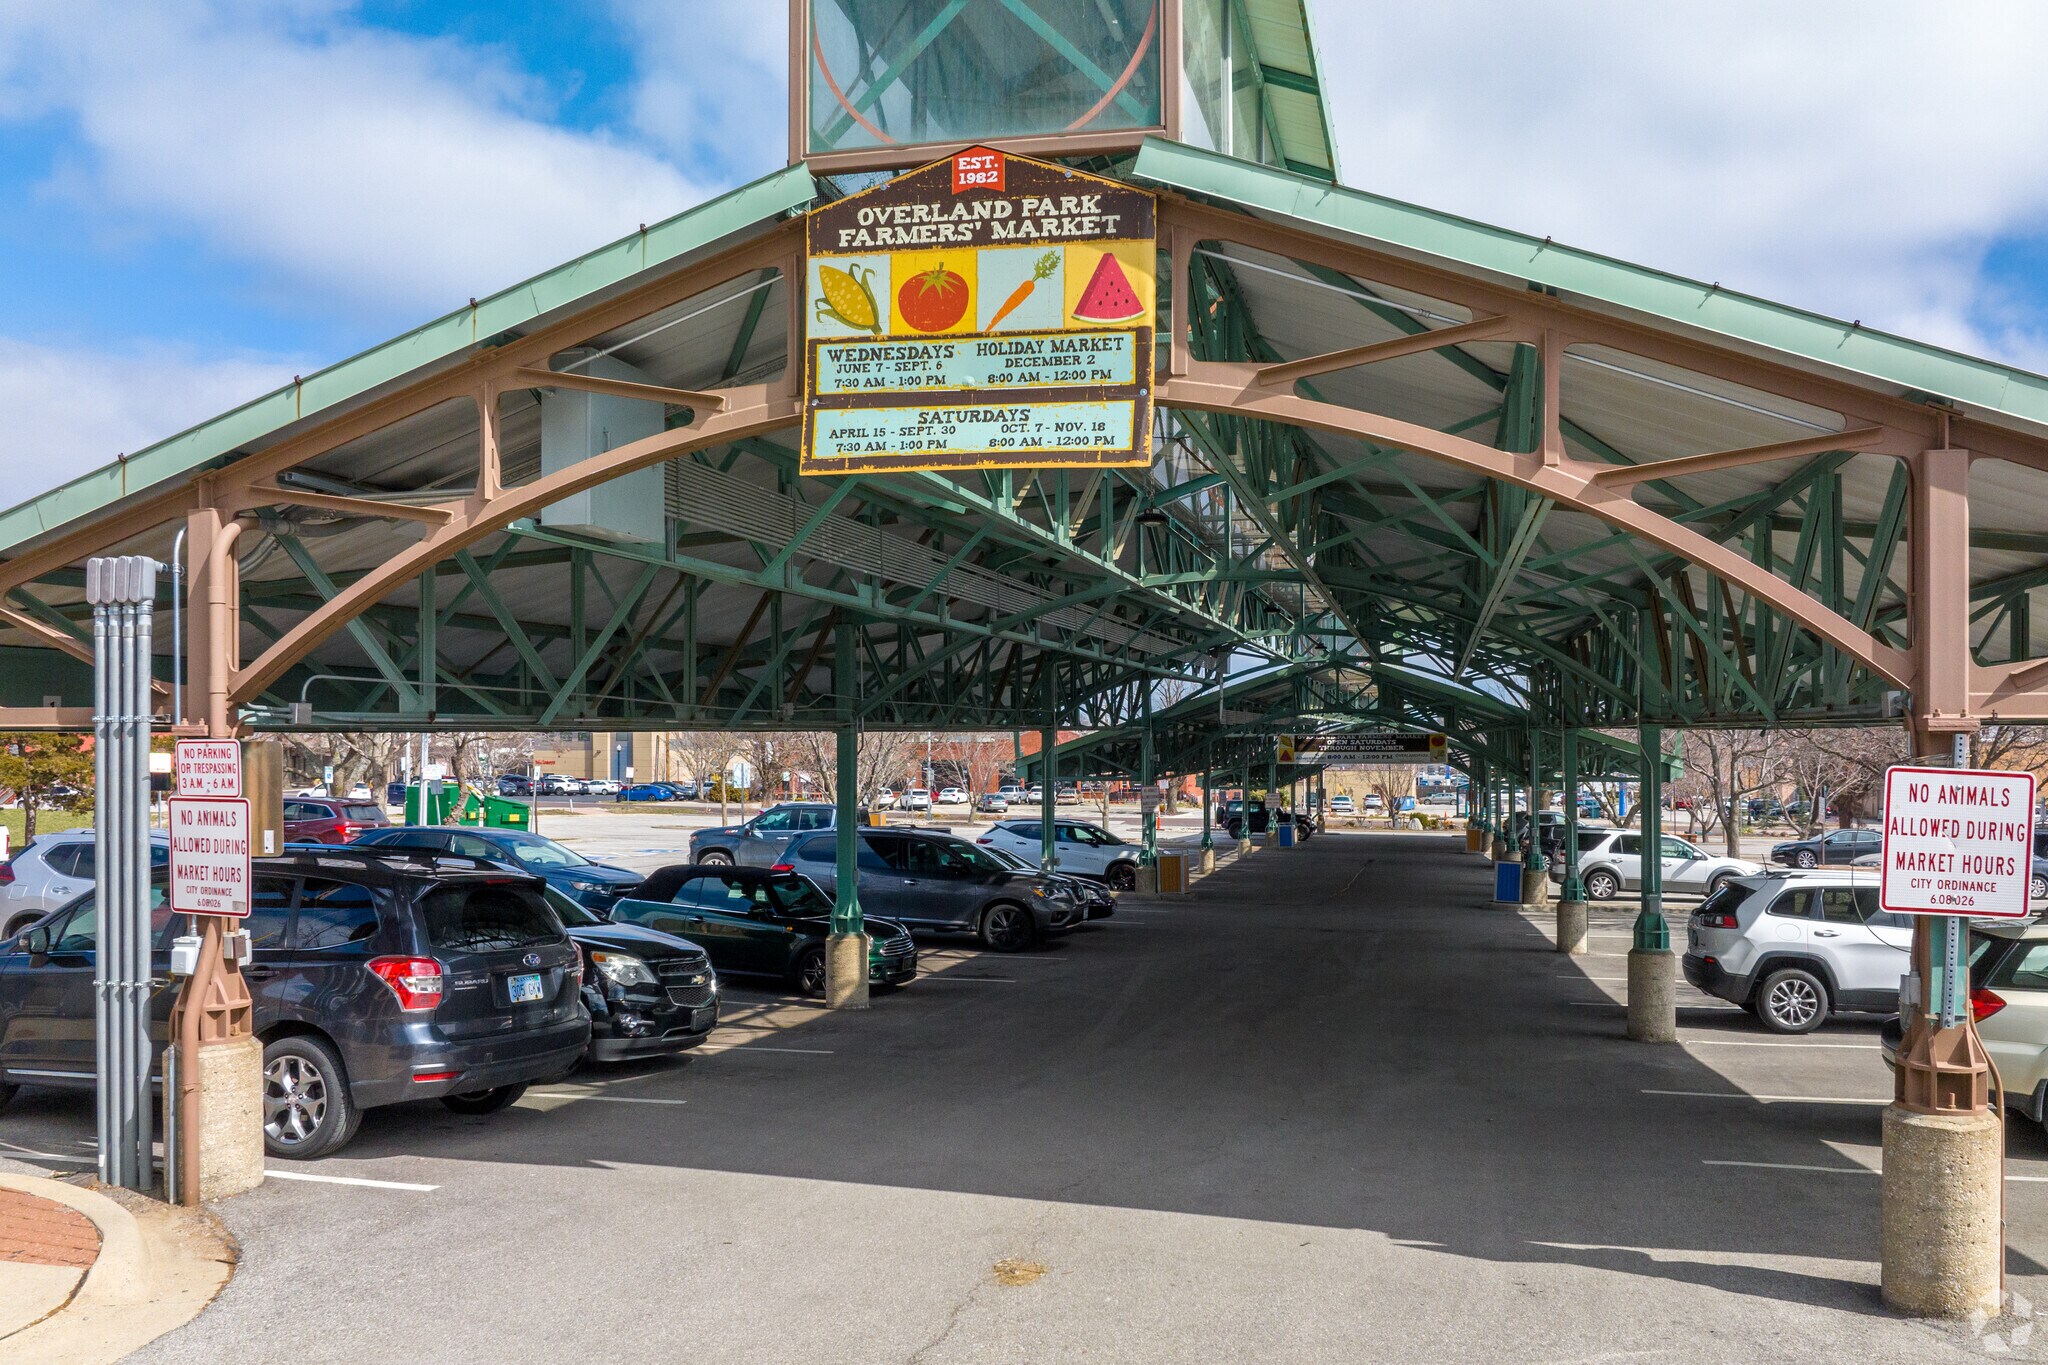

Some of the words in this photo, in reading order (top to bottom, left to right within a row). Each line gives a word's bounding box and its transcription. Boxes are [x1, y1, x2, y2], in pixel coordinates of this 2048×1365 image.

[958, 155, 998, 170] EST.
[958, 170, 998, 185] 1982
[857, 200, 1013, 226] OVERLAND
[1021, 194, 1102, 217] PARK
[839, 222, 982, 247] FARMERS'
[991, 214, 1121, 240] MARKET
[827, 345, 955, 362] WEDNESDAYS
[977, 340, 1044, 357] HOLIDAY
[1050, 337, 1124, 353] MARKET
[837, 363, 870, 374] JUNE
[875, 363, 884, 373] 7
[894, 361, 932, 372] SEPT.
[936, 361, 942, 370] 6
[1005, 355, 1082, 368] DECEMBER
[1087, 355, 1096, 365] 2
[834, 378, 860, 388] 7:30
[863, 377, 886, 387] AM
[899, 376, 922, 386] 1:00
[926, 375, 946, 386] PM
[988, 373, 1014, 384] 8:00
[1017, 372, 1040, 383] AM
[1054, 370, 1086, 381] 12:00
[1091, 369, 1112, 380] PM
[918, 409, 1031, 424] SATURDAYS
[829, 428, 869, 439] APRIL
[872, 428, 886, 438] 15
[899, 426, 936, 437] SEPT.
[941, 425, 956, 435] 30
[1001, 423, 1030, 434] OCT.
[1035, 422, 1044, 432] 7
[1054, 422, 1086, 432] NOV.
[1091, 422, 1106, 432] 18
[836, 442, 861, 453] 7:30
[864, 441, 886, 452] AM
[900, 440, 923, 450] 1:00
[927, 439, 947, 450] PM
[988, 437, 1015, 448] 8:00
[1019, 436, 1043, 447] AM
[1056, 436, 1089, 446] 12:00
[1094, 435, 1115, 446] PM
[184, 748, 195, 759] NO
[197, 748, 232, 759] PARKING
[181, 763, 191, 774] OR
[194, 763, 236, 774] TRESPASSING
[182, 778, 187, 788] 3
[213, 778, 218, 789] 6
[1909, 783, 1929, 803] NO
[1938, 784, 2011, 807] ANIMALS
[180, 810, 193, 826] NO
[197, 810, 237, 827] ANIMALS
[1890, 816, 1960, 839] ALLOWED
[1966, 820, 2025, 842] DURING
[173, 837, 211, 853] ALLOWED
[213, 839, 246, 855] DURING
[1896, 851, 1955, 873] MARKET
[1962, 854, 2015, 876] HOURS
[177, 864, 209, 880] MARKET
[213, 866, 242, 883] HOURS
[186, 886, 198, 894] CITY
[200, 886, 232, 896] ORDINANCE
[1911, 878, 1932, 889] CITY
[1937, 879, 1997, 893] ORDINANCE
[512, 984, 526, 998] 305
